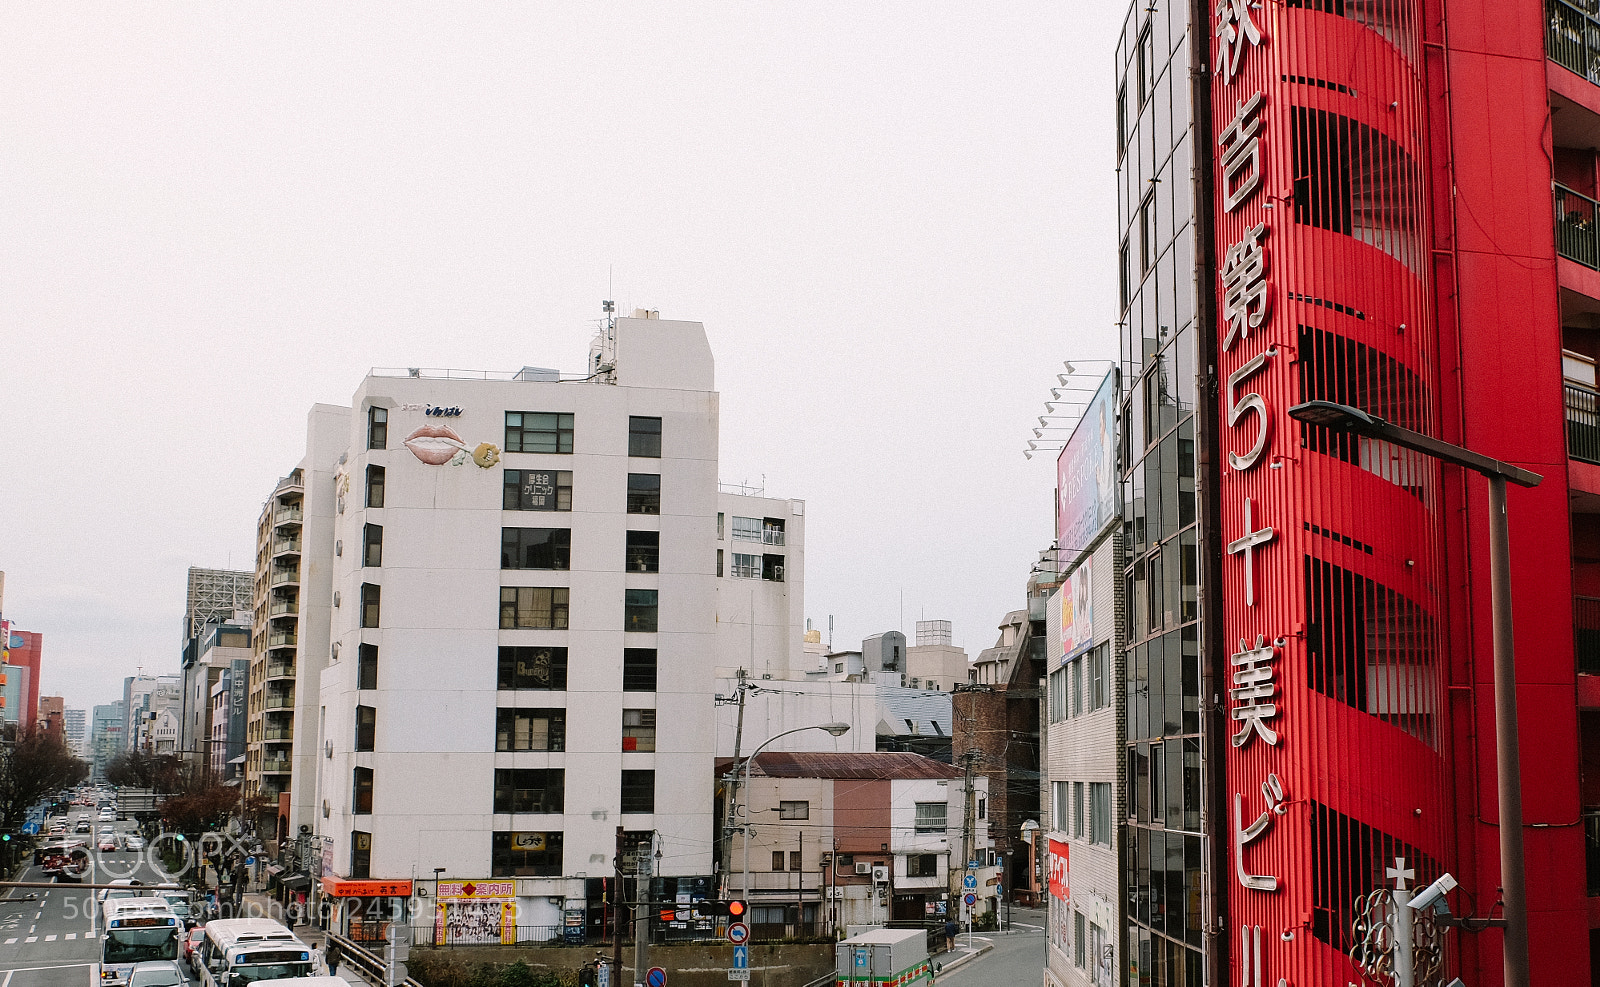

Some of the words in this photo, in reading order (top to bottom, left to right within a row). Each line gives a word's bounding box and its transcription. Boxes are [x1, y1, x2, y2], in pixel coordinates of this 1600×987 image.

[528, 473, 549, 485] 厚生会
[524, 484, 553, 495] クリニック
[531, 495, 546, 506] 福岡
[438, 883, 463, 896] 無料
[475, 882, 514, 896] 案内所
